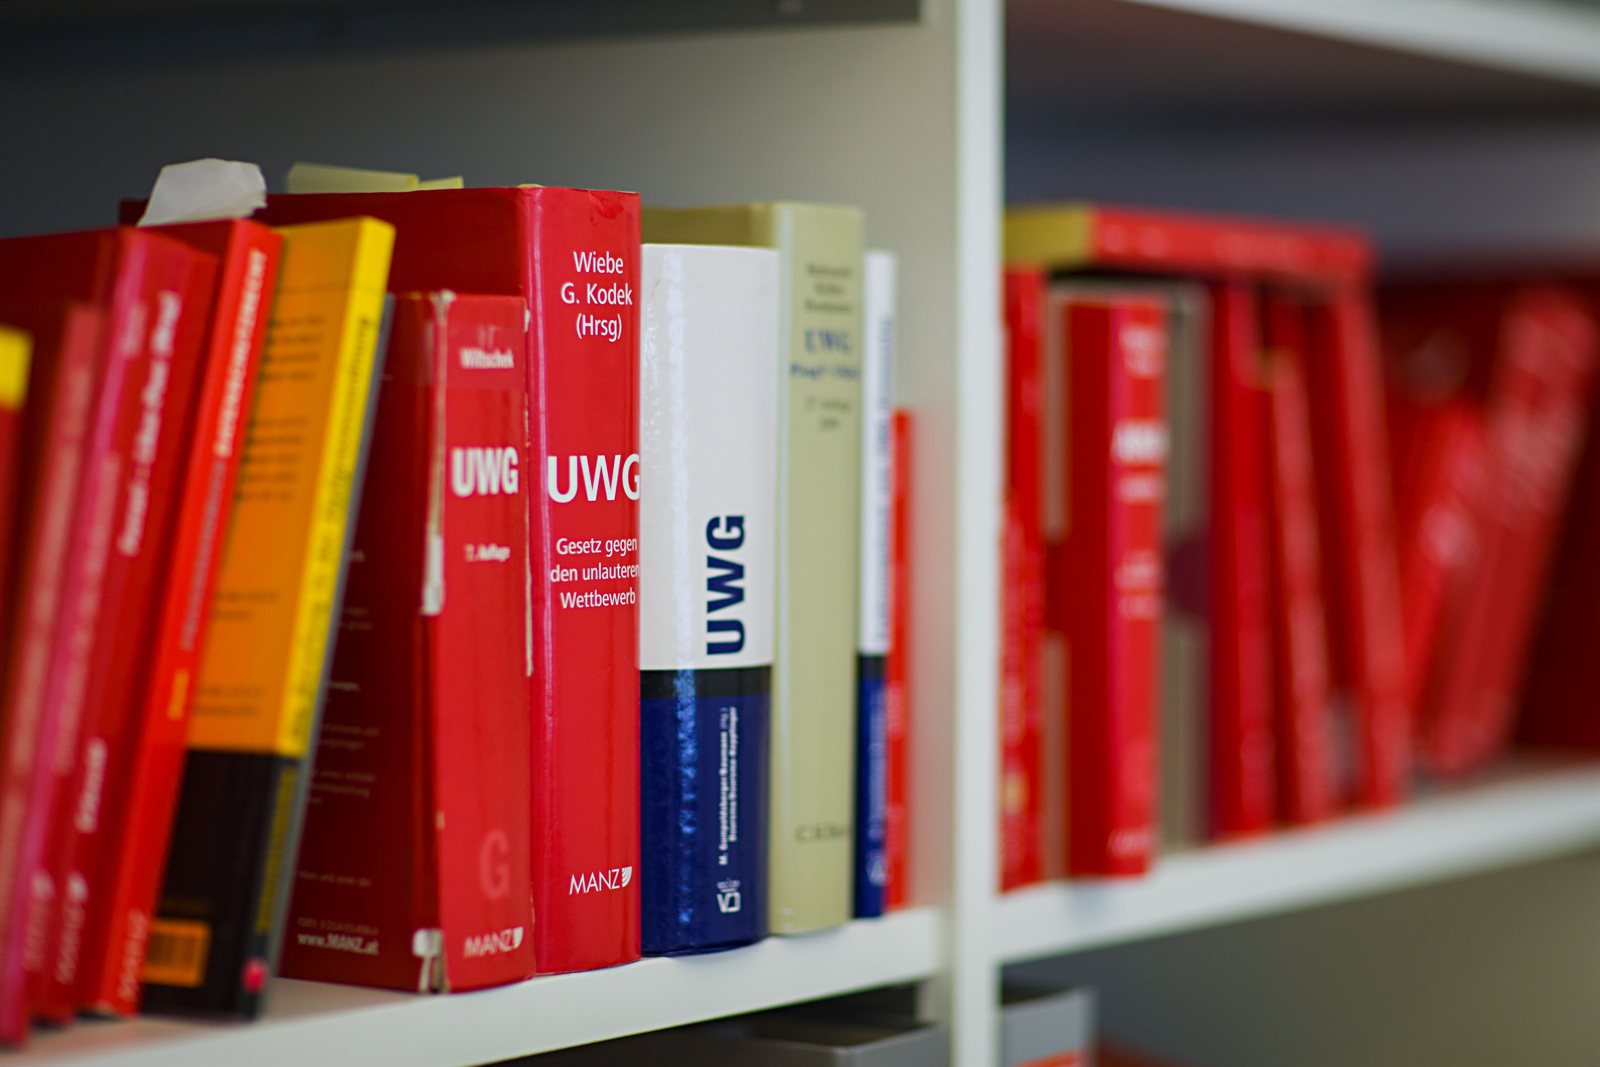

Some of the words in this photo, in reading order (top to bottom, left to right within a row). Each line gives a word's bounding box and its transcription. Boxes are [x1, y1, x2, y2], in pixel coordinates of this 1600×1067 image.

[573, 251, 624, 274] Wiebe
[561, 282, 580, 304] G.
[587, 283, 633, 305] Kodek
[576, 313, 623, 342] (Hrsg)
[452, 446, 519, 497] UWG
[547, 453, 641, 503] UWG
[556, 537, 601, 555] Gesetz
[605, 537, 638, 558] gegen
[550, 564, 578, 582] den
[705, 515, 745, 655] UWG
[560, 587, 636, 609] Wettbewerb
[569, 868, 620, 895] MANZ
[463, 929, 513, 959] MANZ
